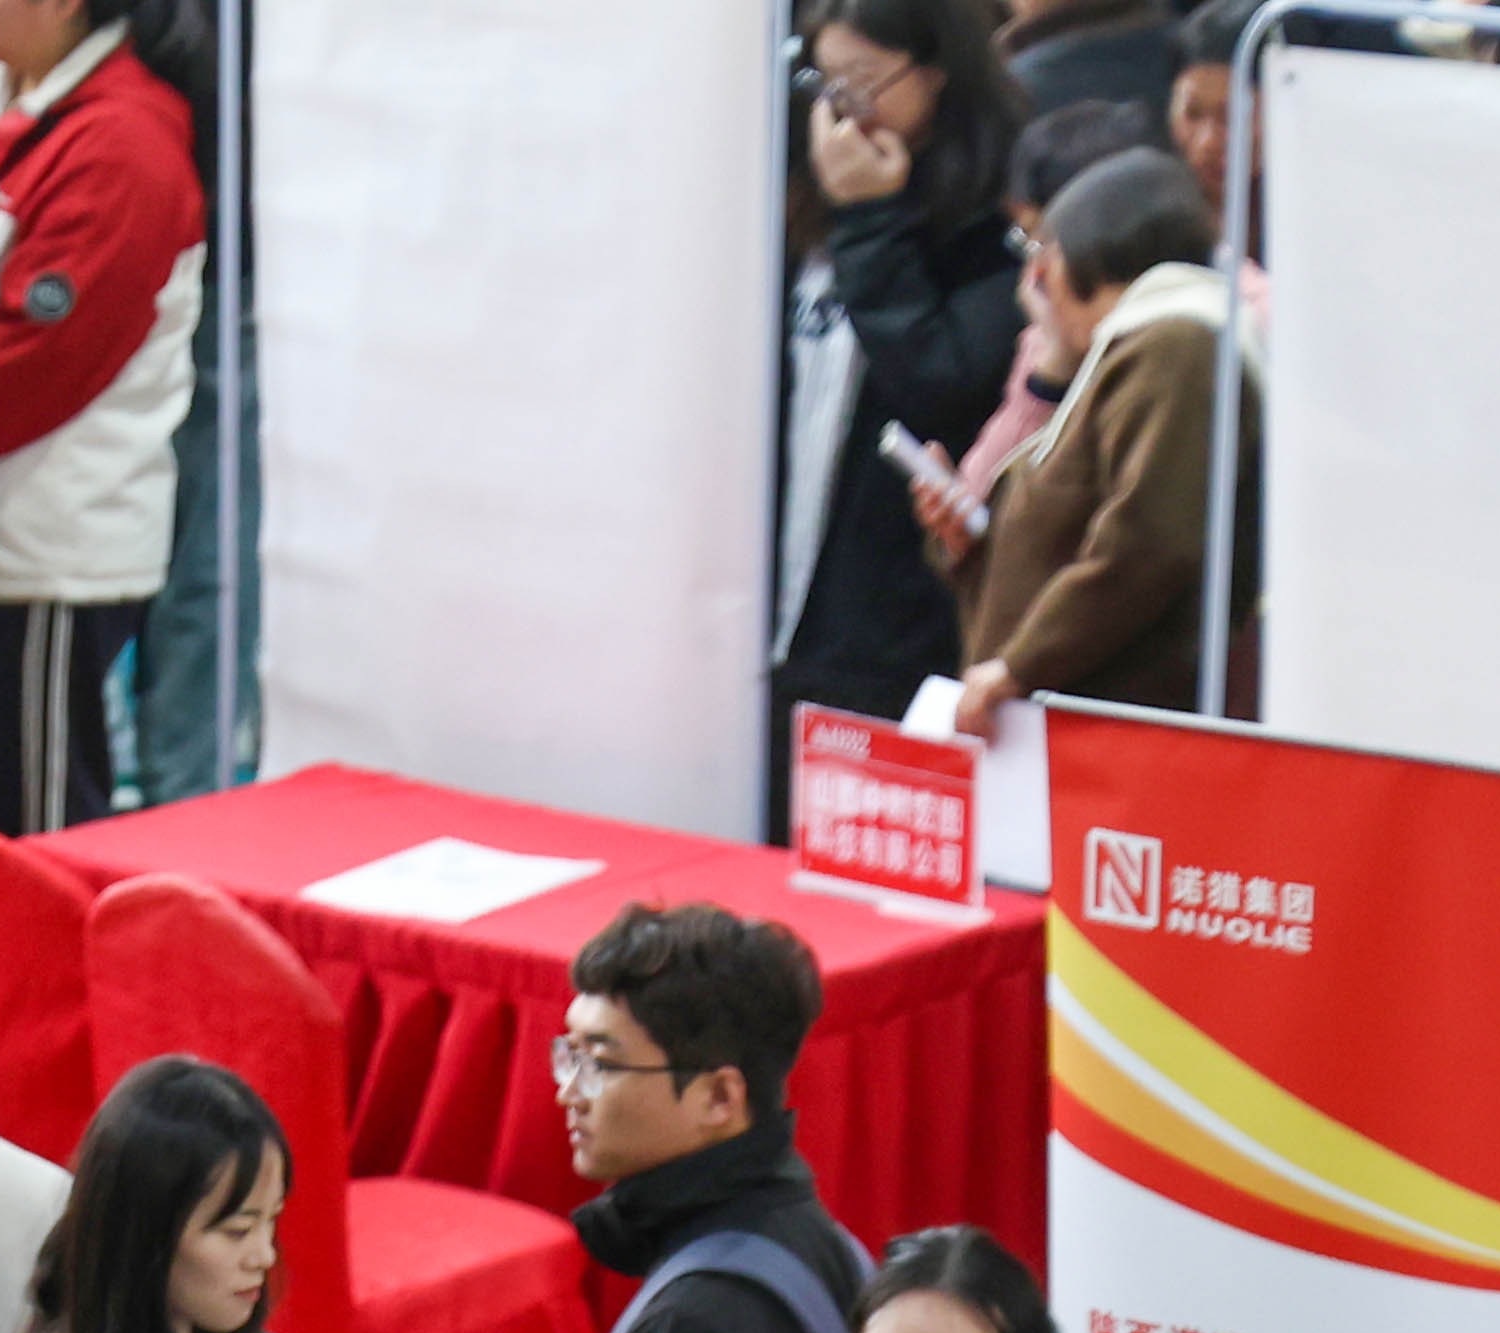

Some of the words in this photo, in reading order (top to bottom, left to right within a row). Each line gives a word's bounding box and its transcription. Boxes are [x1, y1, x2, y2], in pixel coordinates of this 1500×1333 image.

[1170, 865, 1316, 922] 诺猎集团
[1165, 908, 1314, 954] NUOLIE
